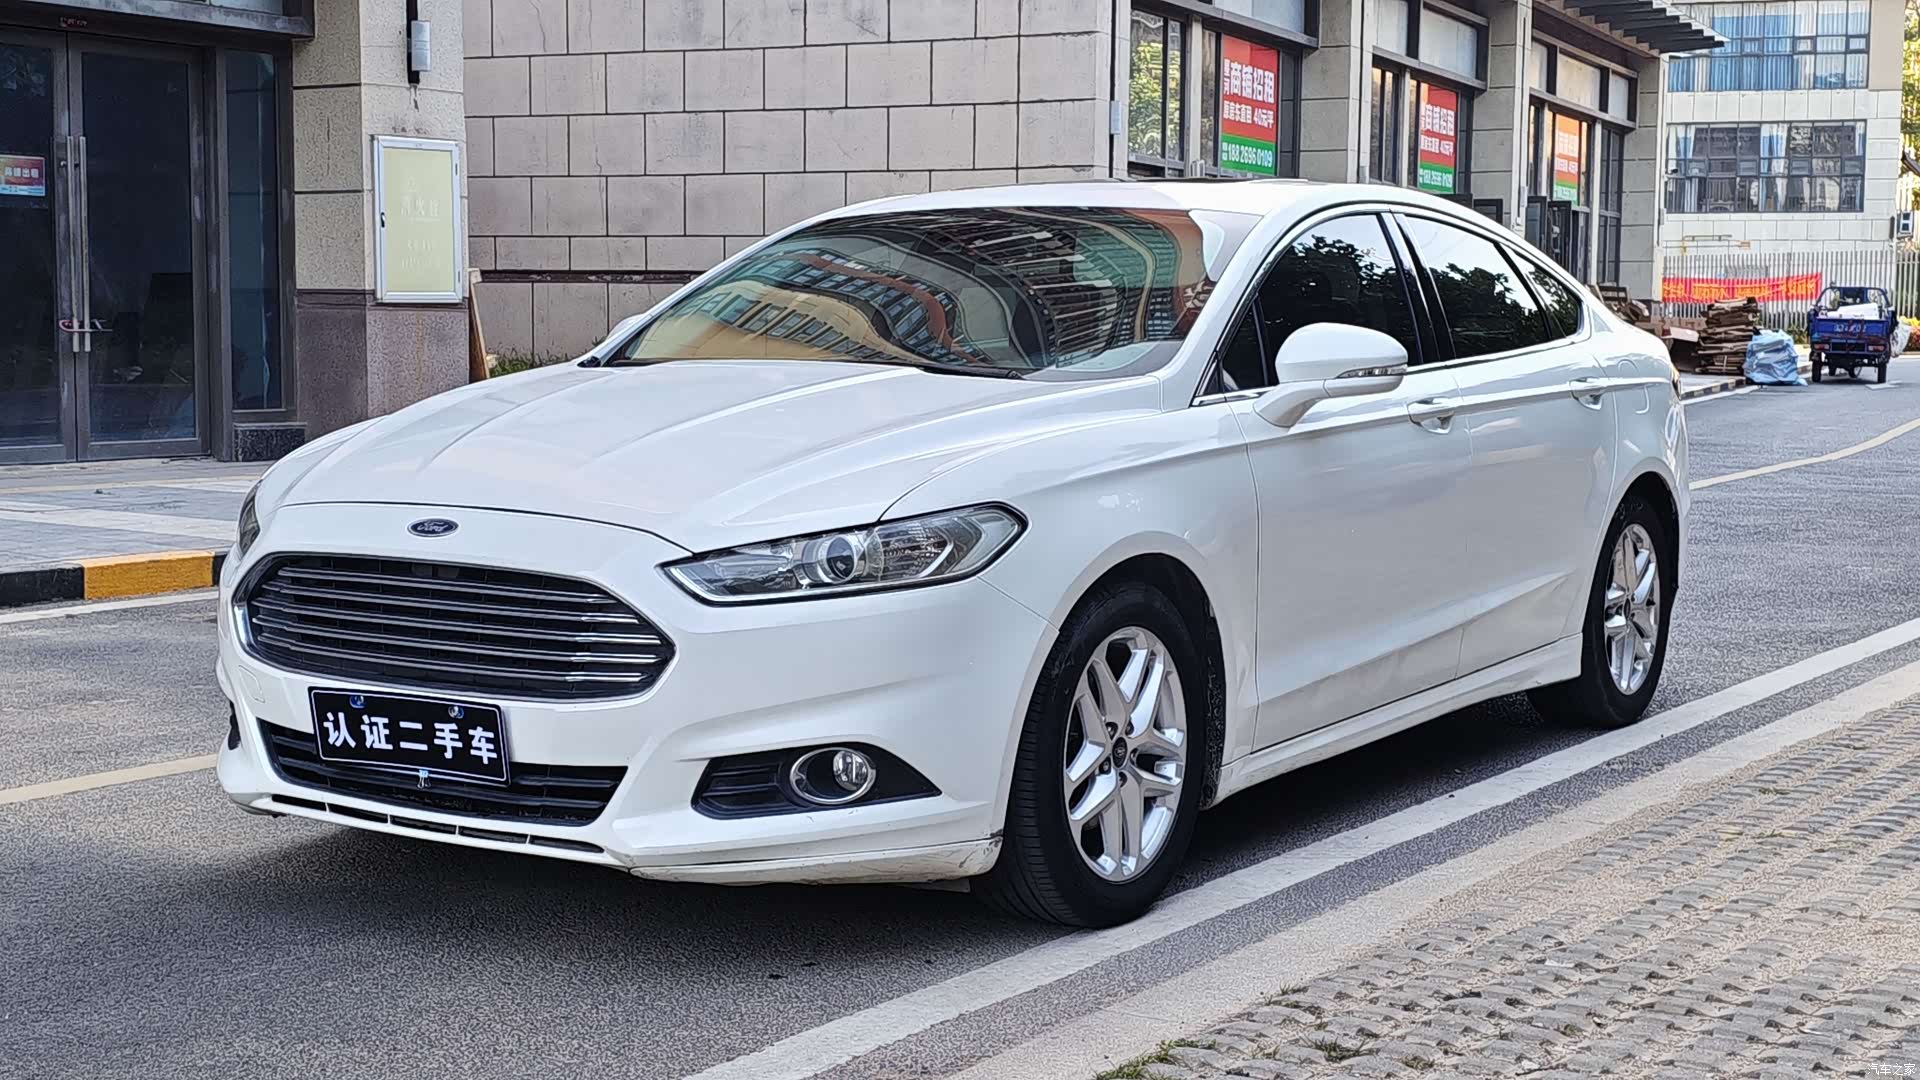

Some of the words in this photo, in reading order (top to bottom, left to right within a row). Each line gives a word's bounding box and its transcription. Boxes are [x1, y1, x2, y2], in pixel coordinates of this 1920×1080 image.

[1230, 62, 1275, 103] 商铺招租
[417, 520, 449, 532] Ford
[323, 711, 498, 765] 认证二手车
